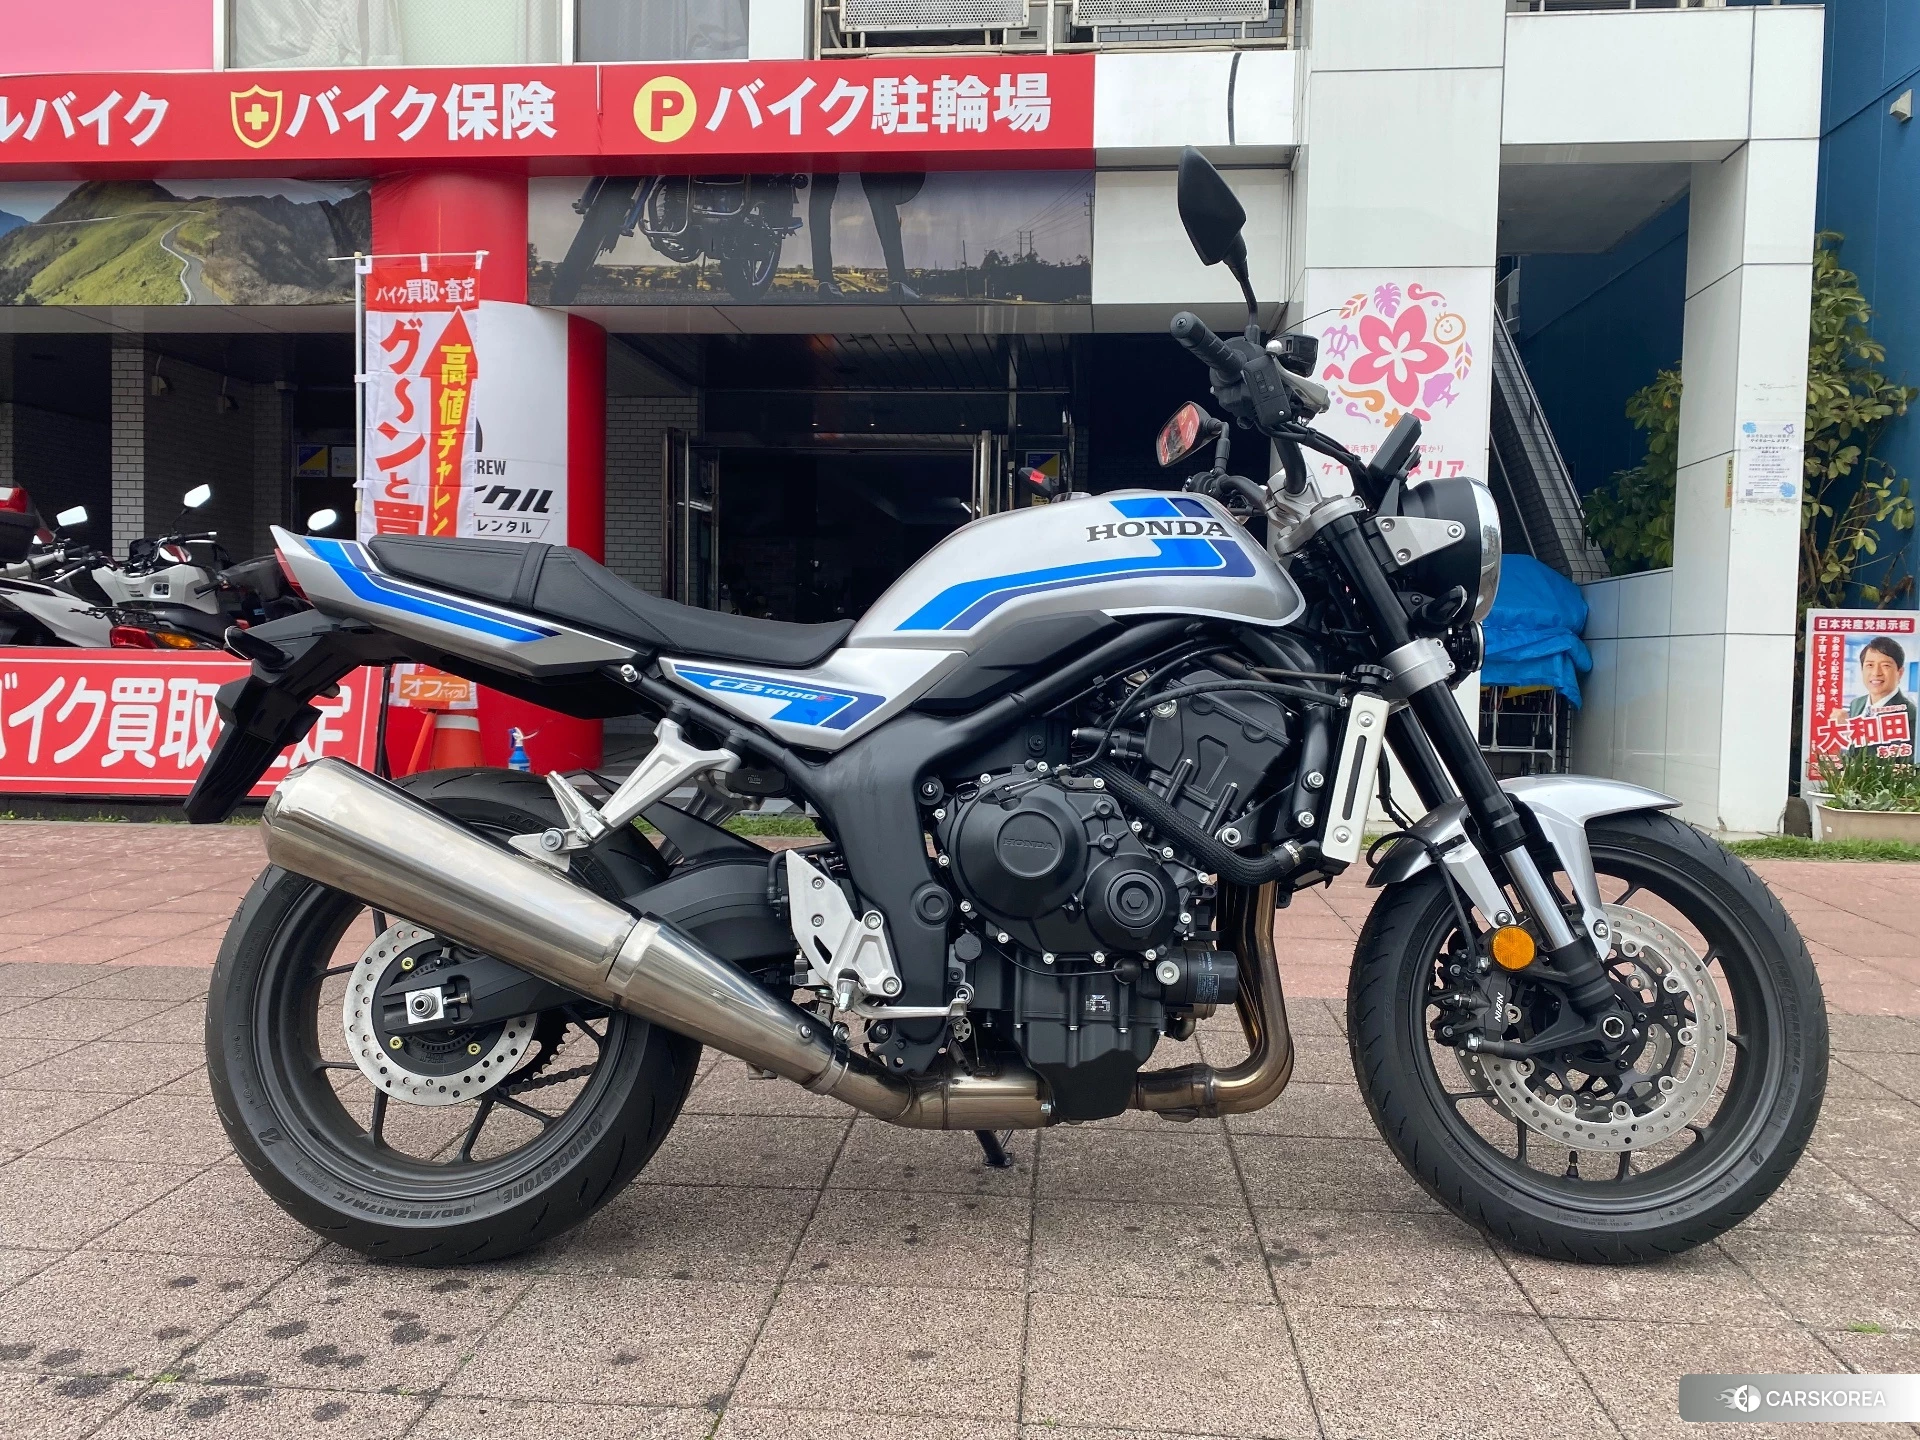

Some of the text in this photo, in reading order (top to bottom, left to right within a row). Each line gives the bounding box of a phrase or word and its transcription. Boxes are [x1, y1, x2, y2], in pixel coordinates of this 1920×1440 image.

[286, 81, 557, 142] バイク保険
[705, 73, 1052, 136] バイク駐輪場
[375, 276, 476, 304] バイク買取・査定
[474, 459, 506, 476] REW
[477, 519, 532, 534] レンタル
[1086, 520, 1232, 542] HONDA
[1818, 619, 1911, 631] 日本共産党掲示板
[1815, 635, 1828, 719] 子育てしやすい横浜へ
[1817, 712, 1911, 753] 大和田
[1003, 837, 1056, 851] HONDA
[502, 1119, 603, 1205] BRIDGESTONE
